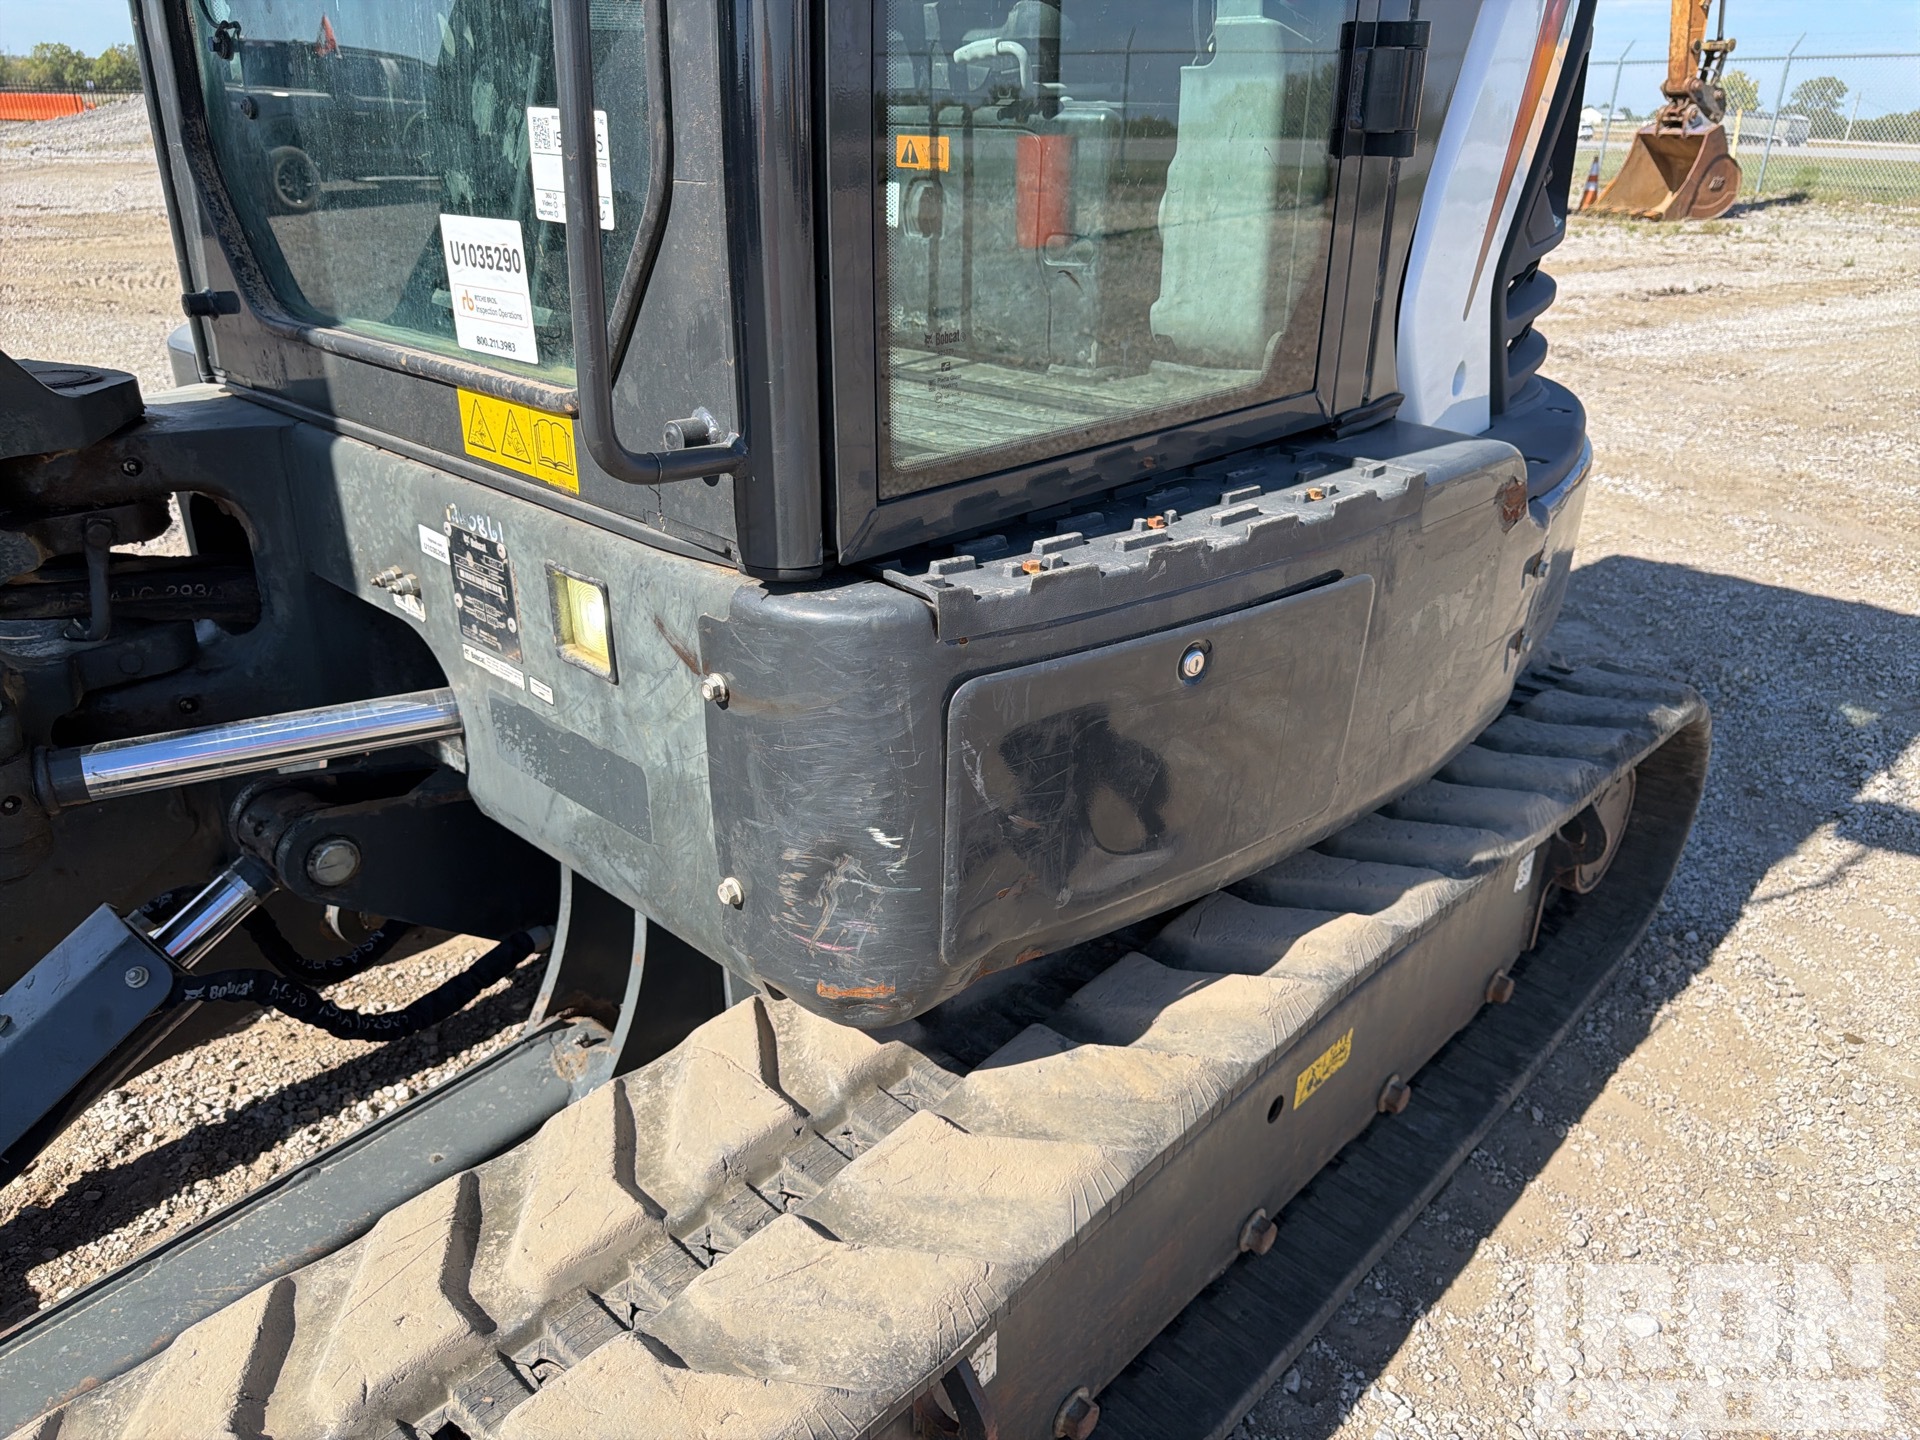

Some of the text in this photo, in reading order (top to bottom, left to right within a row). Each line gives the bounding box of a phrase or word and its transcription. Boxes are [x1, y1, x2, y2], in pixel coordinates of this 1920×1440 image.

[449, 240, 521, 274] U1035290
[476, 305, 523, 321] Inspection Operations
[209, 979, 255, 999] Bobcat
